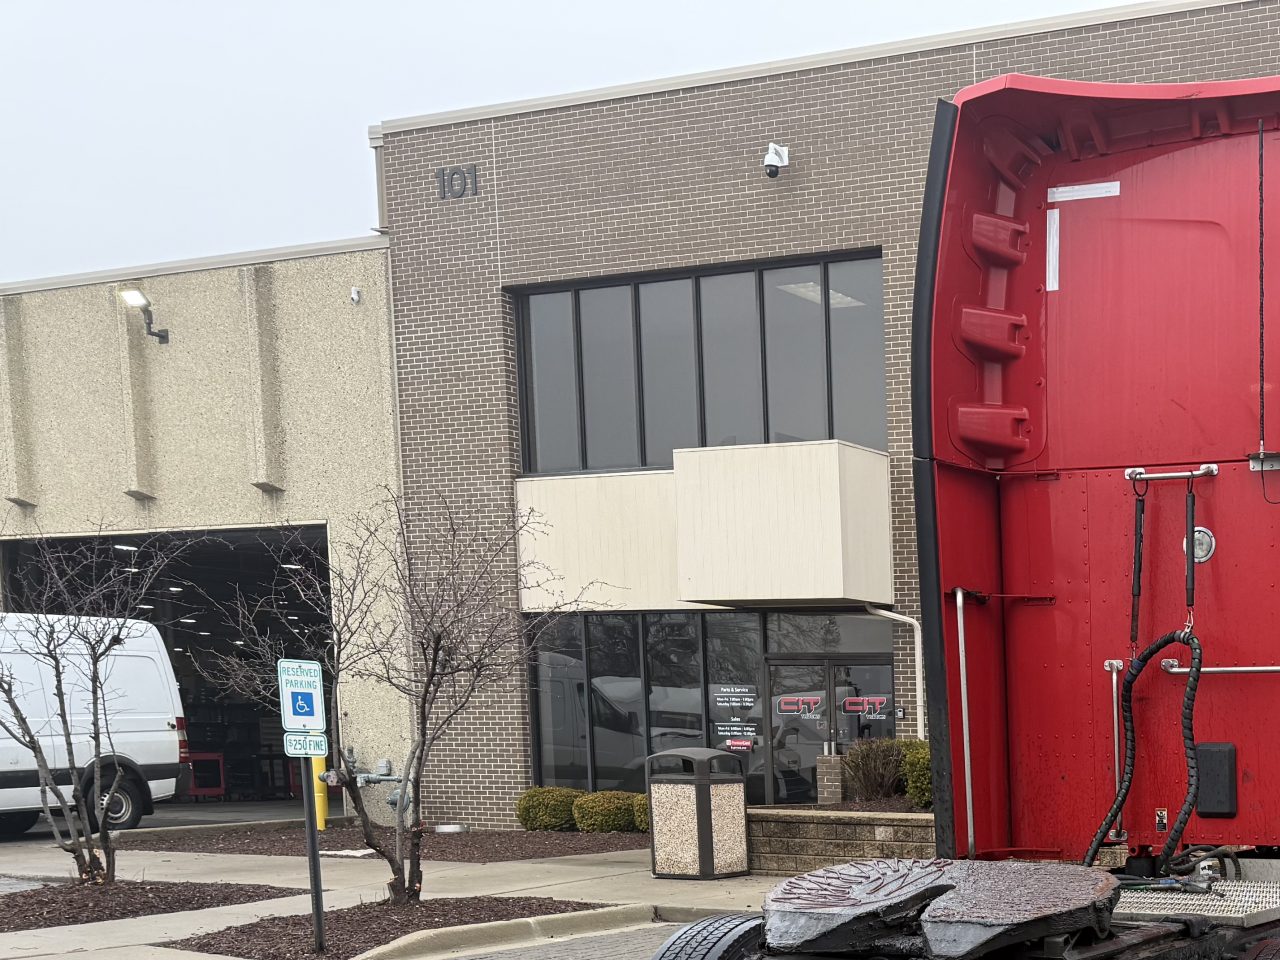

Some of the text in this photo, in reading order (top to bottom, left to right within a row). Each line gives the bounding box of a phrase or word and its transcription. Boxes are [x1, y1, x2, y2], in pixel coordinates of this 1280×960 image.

[435, 164, 477, 199] 101
[281, 666, 318, 678] RESERVED
[285, 679, 317, 690] PARKING
[777, 697, 820, 714] CIT
[842, 697, 886, 714] CIT
[288, 739, 325, 752] $250 FINE
